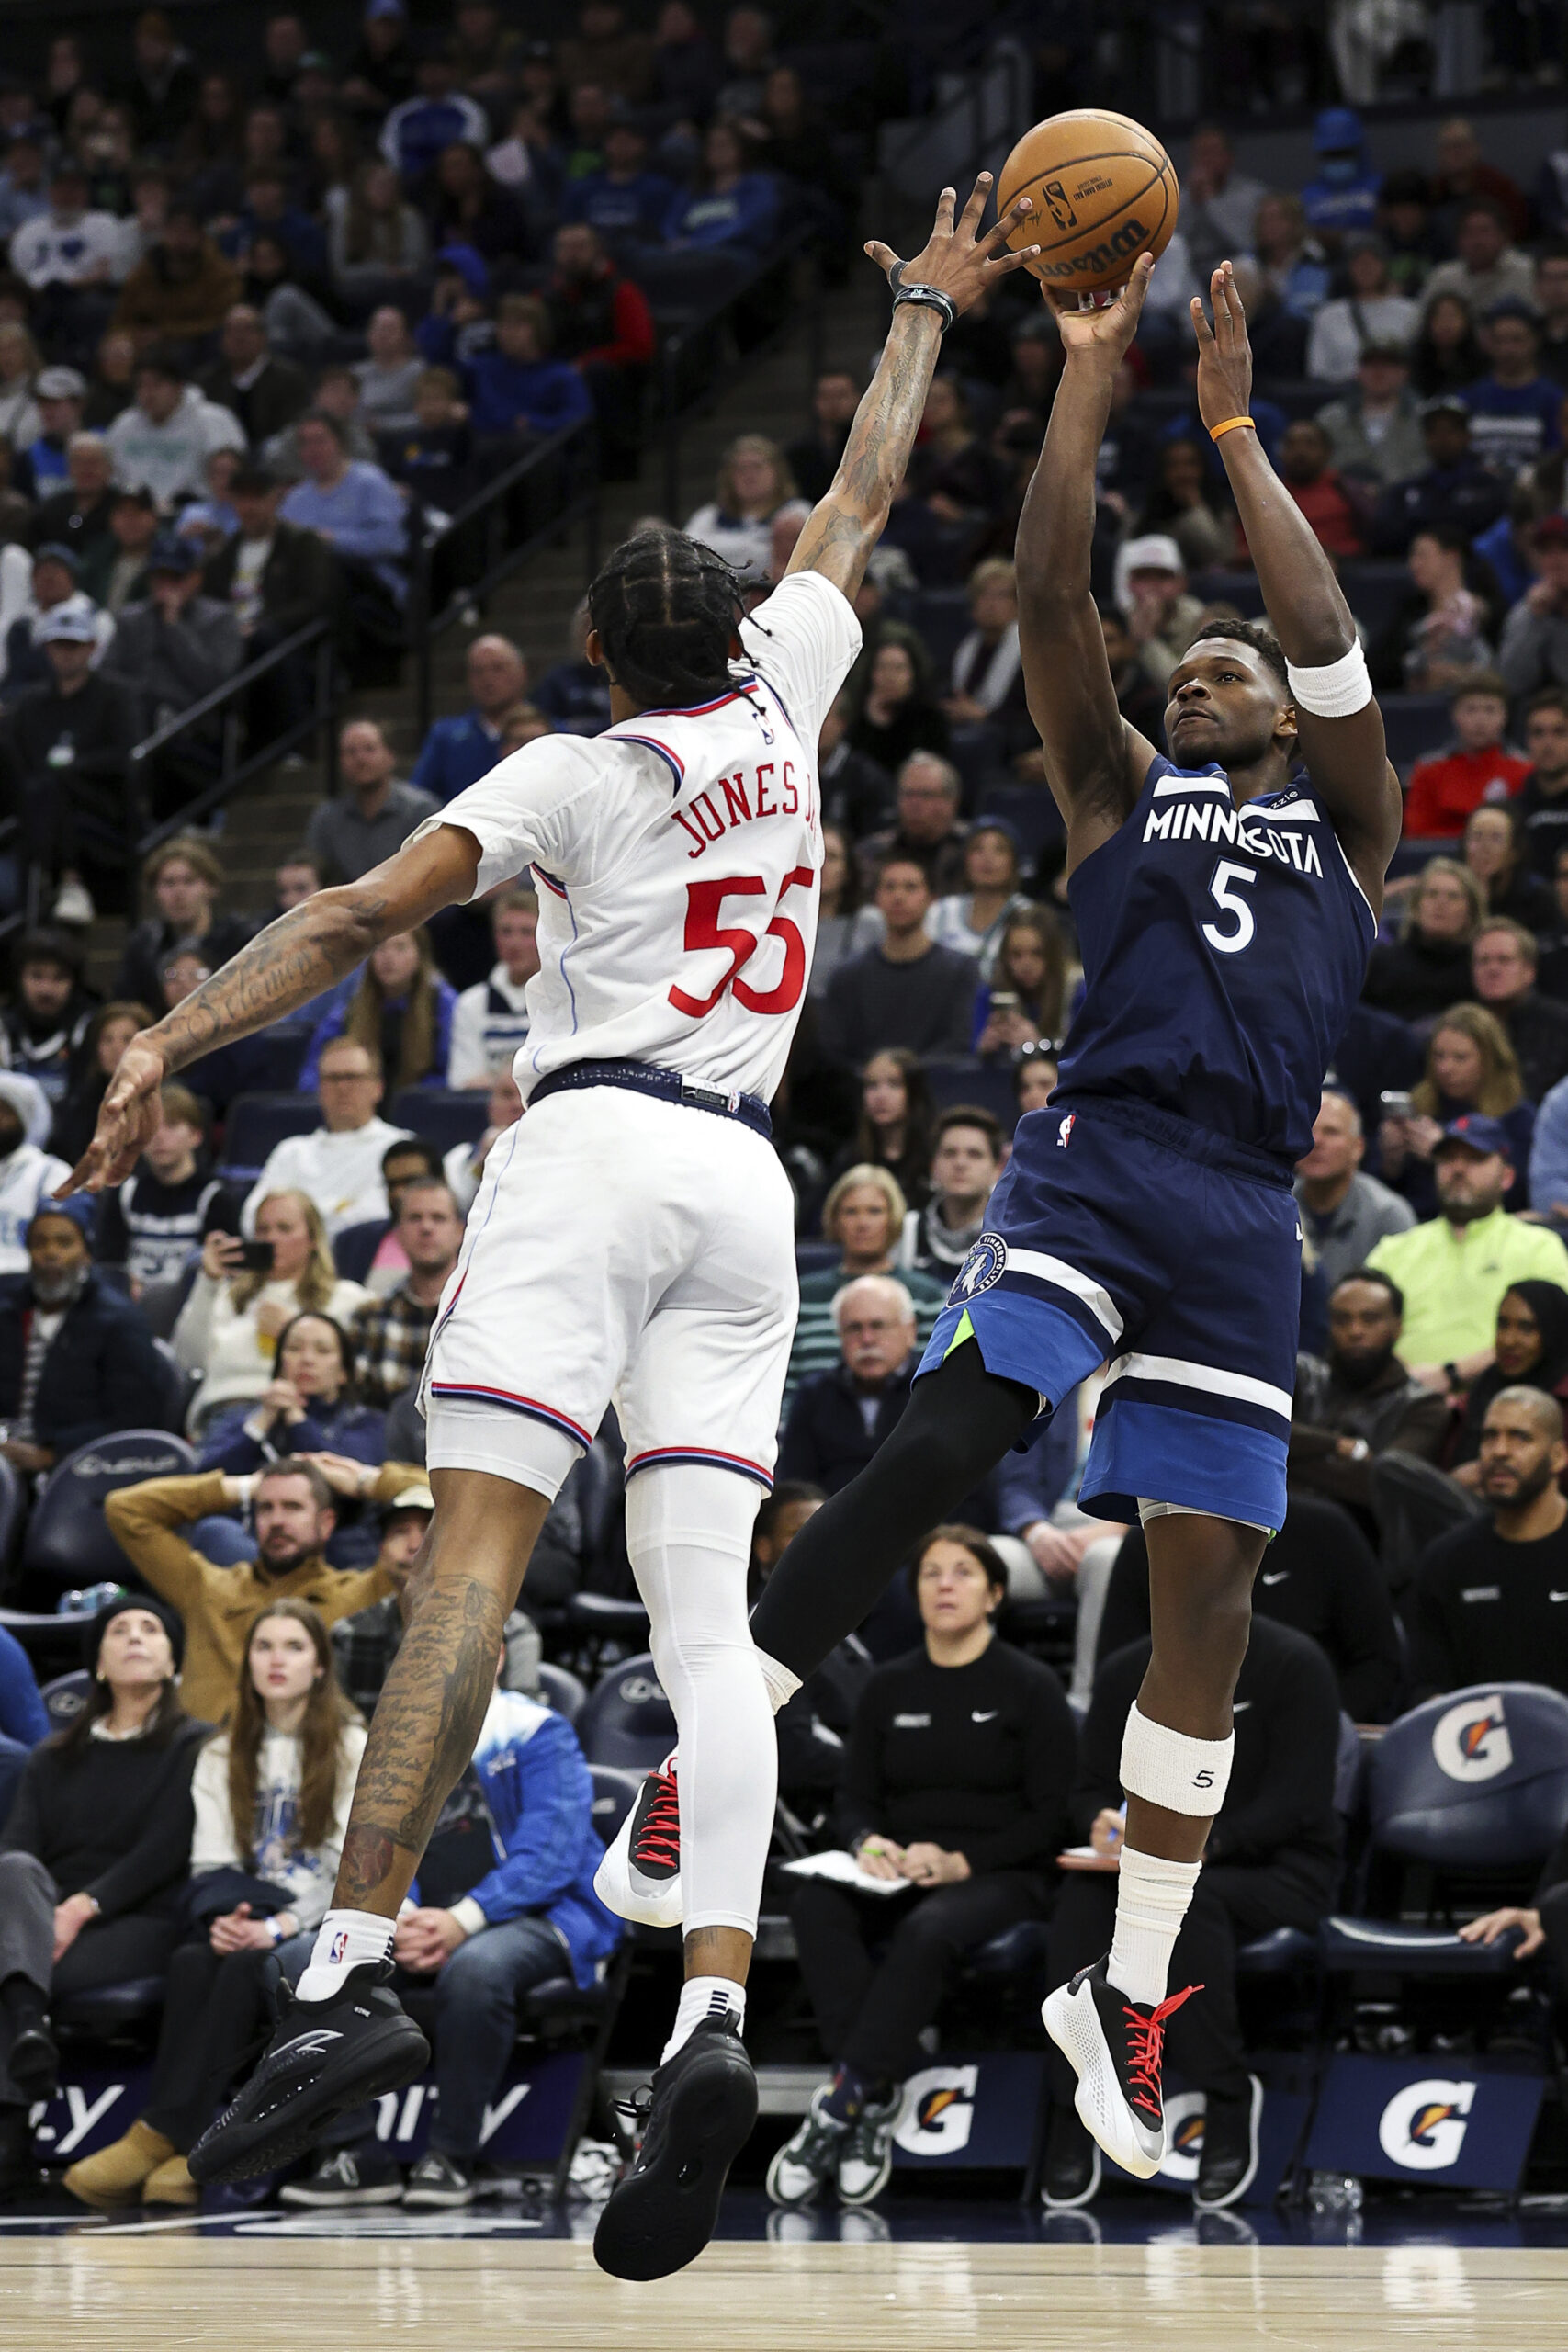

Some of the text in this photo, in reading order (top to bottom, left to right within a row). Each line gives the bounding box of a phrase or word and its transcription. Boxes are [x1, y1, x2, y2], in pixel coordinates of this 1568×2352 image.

[1034, 219, 1150, 279] Wilson
[671, 761, 798, 859] JONES
[667, 866, 815, 1018] 55
[1201, 859, 1258, 954] 5
[1191, 1770, 1214, 1788] 5
[1432, 1694, 1513, 1782] G
[893, 2064, 978, 2156] G
[1380, 2078, 1475, 2170] G
